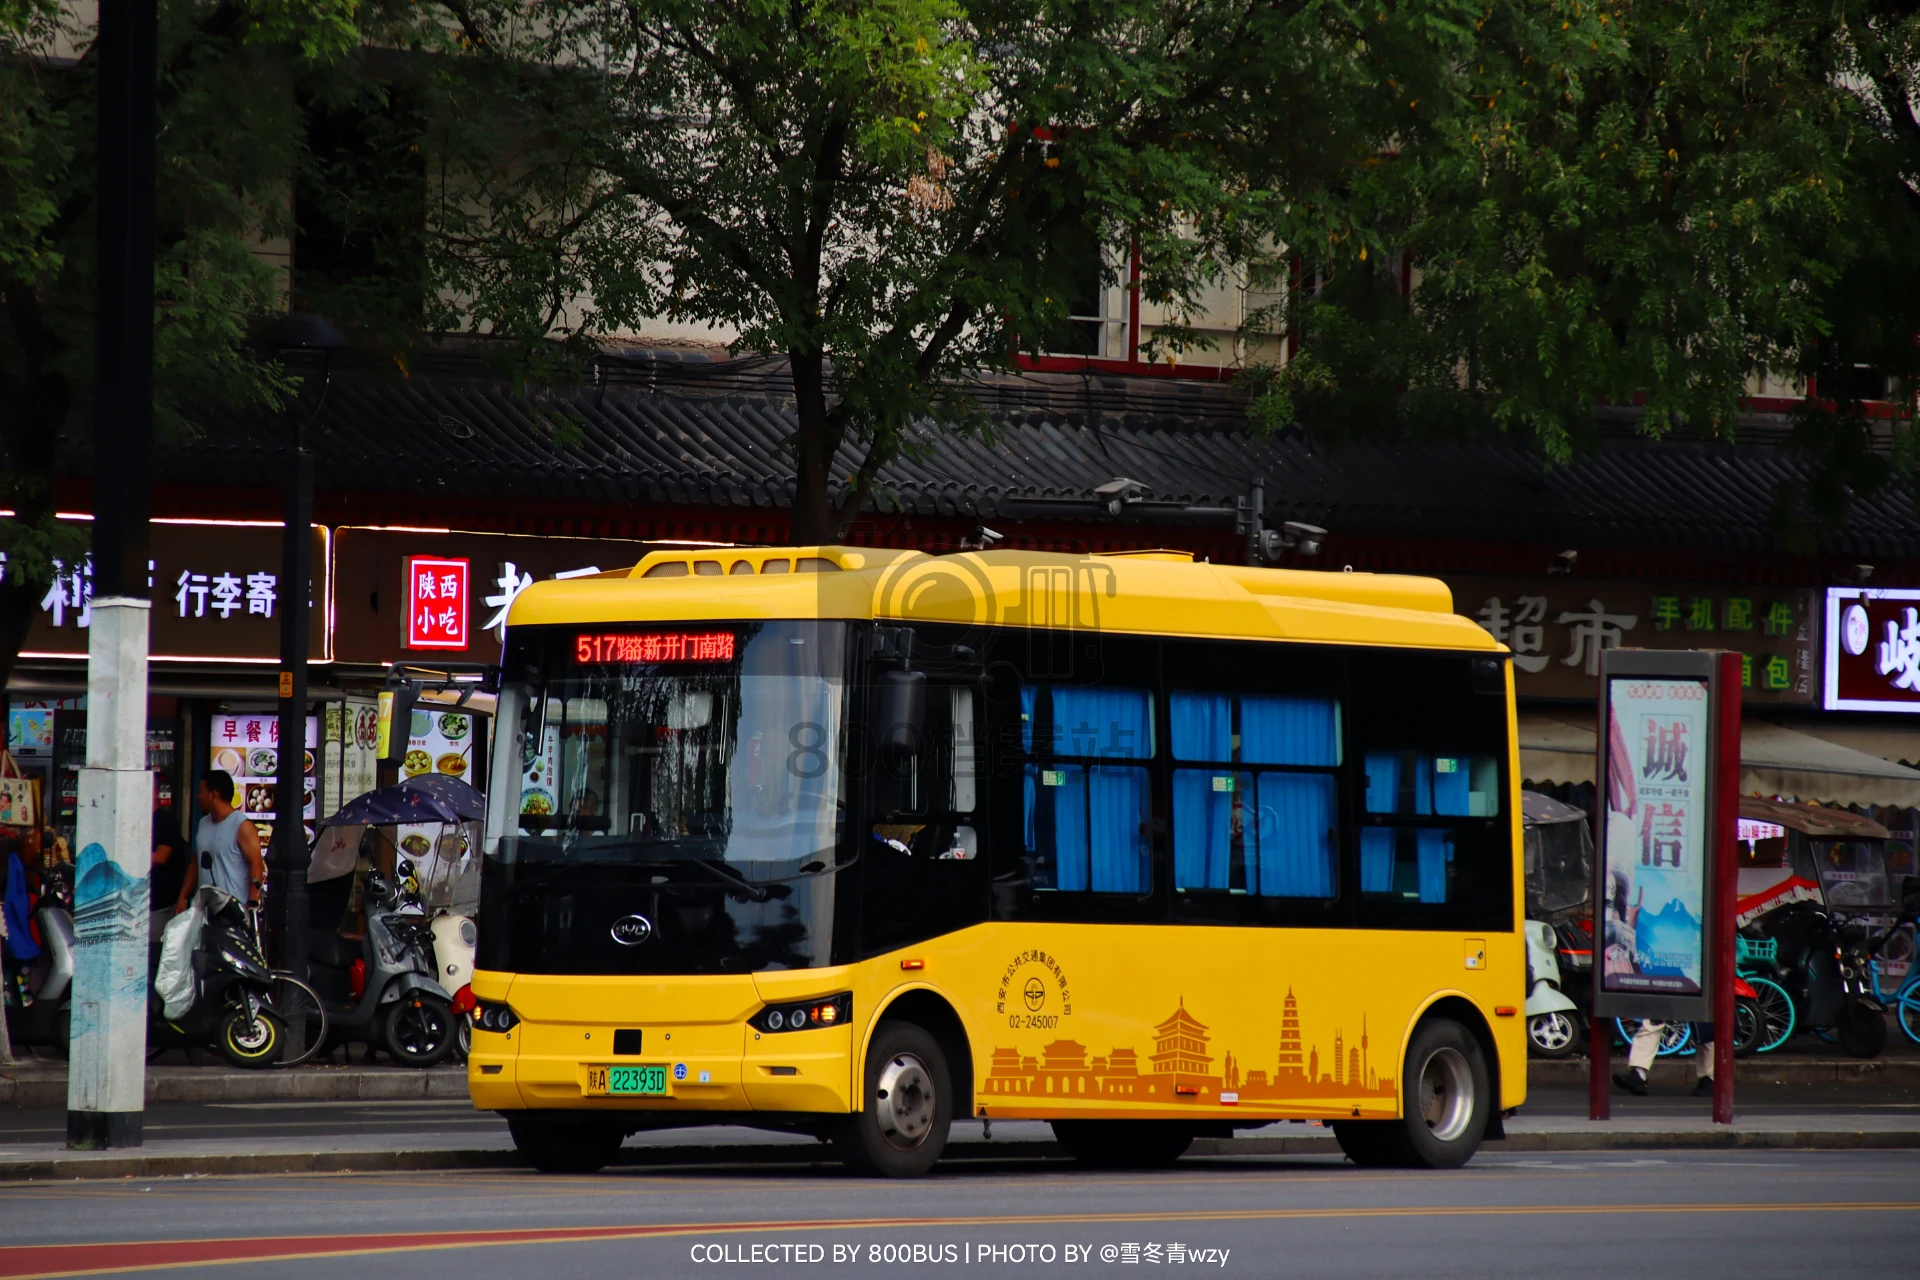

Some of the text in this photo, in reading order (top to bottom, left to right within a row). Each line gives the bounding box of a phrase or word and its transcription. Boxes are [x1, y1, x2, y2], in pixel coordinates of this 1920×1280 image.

[175, 570, 312, 618] 行李寄
[418, 571, 458, 600] 陕西
[417, 606, 459, 635] 小吃
[1656, 596, 1793, 635] 手机配件
[1477, 595, 1638, 677] 超市
[223, 720, 306, 743] 早餐供
[615, 924, 646, 936] BYD
[997, 949, 1071, 1016] 西安市公共交通集团有限公司
[1009, 1015, 1059, 1029] 02-245007
[589, 1070, 665, 1091] 陕A22393D
